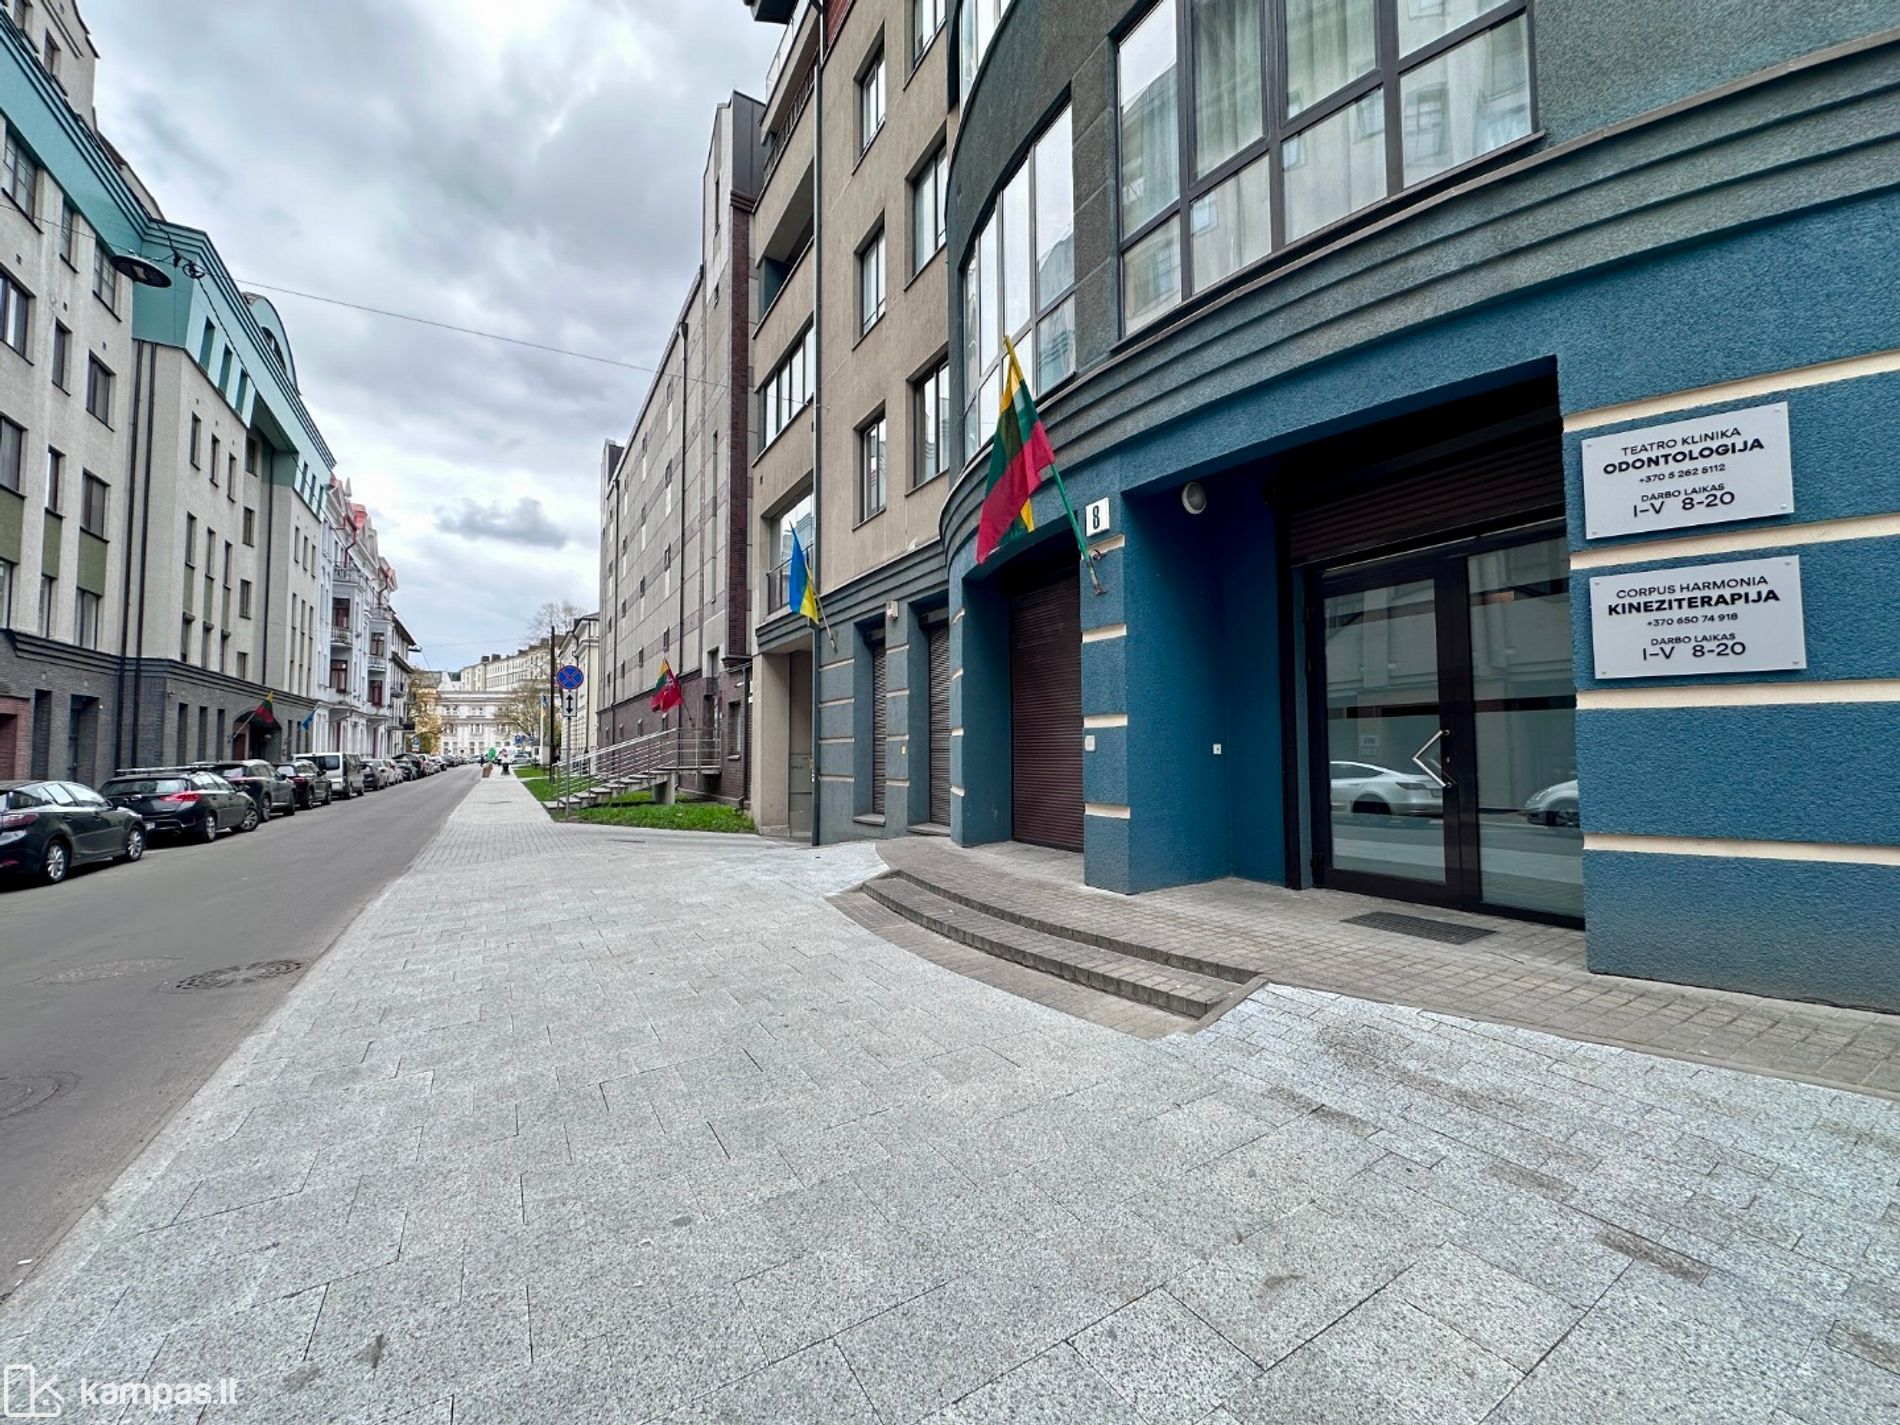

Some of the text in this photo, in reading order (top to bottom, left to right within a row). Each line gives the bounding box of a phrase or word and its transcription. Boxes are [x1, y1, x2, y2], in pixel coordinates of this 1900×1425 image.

[1621, 427, 1742, 457] TEATRO KLINIKA
[1603, 438, 1764, 475] ODONTOLOGIJA
[1639, 463, 1726, 483] +370 5 262 5112
[1641, 483, 1725, 503] DARBO LAIKAS
[1681, 490, 1735, 511] 8-20
[1093, 505, 1100, 530] 8
[1616, 575, 1768, 599] CORPUS HARMONIA
[1607, 589, 1781, 616] KINEZITERAPIJA
[1647, 612, 1739, 627] +370 650 74 918
[1650, 632, 1736, 647] DARBO LAIKAS
[1692, 641, 1746, 658] 8-20
